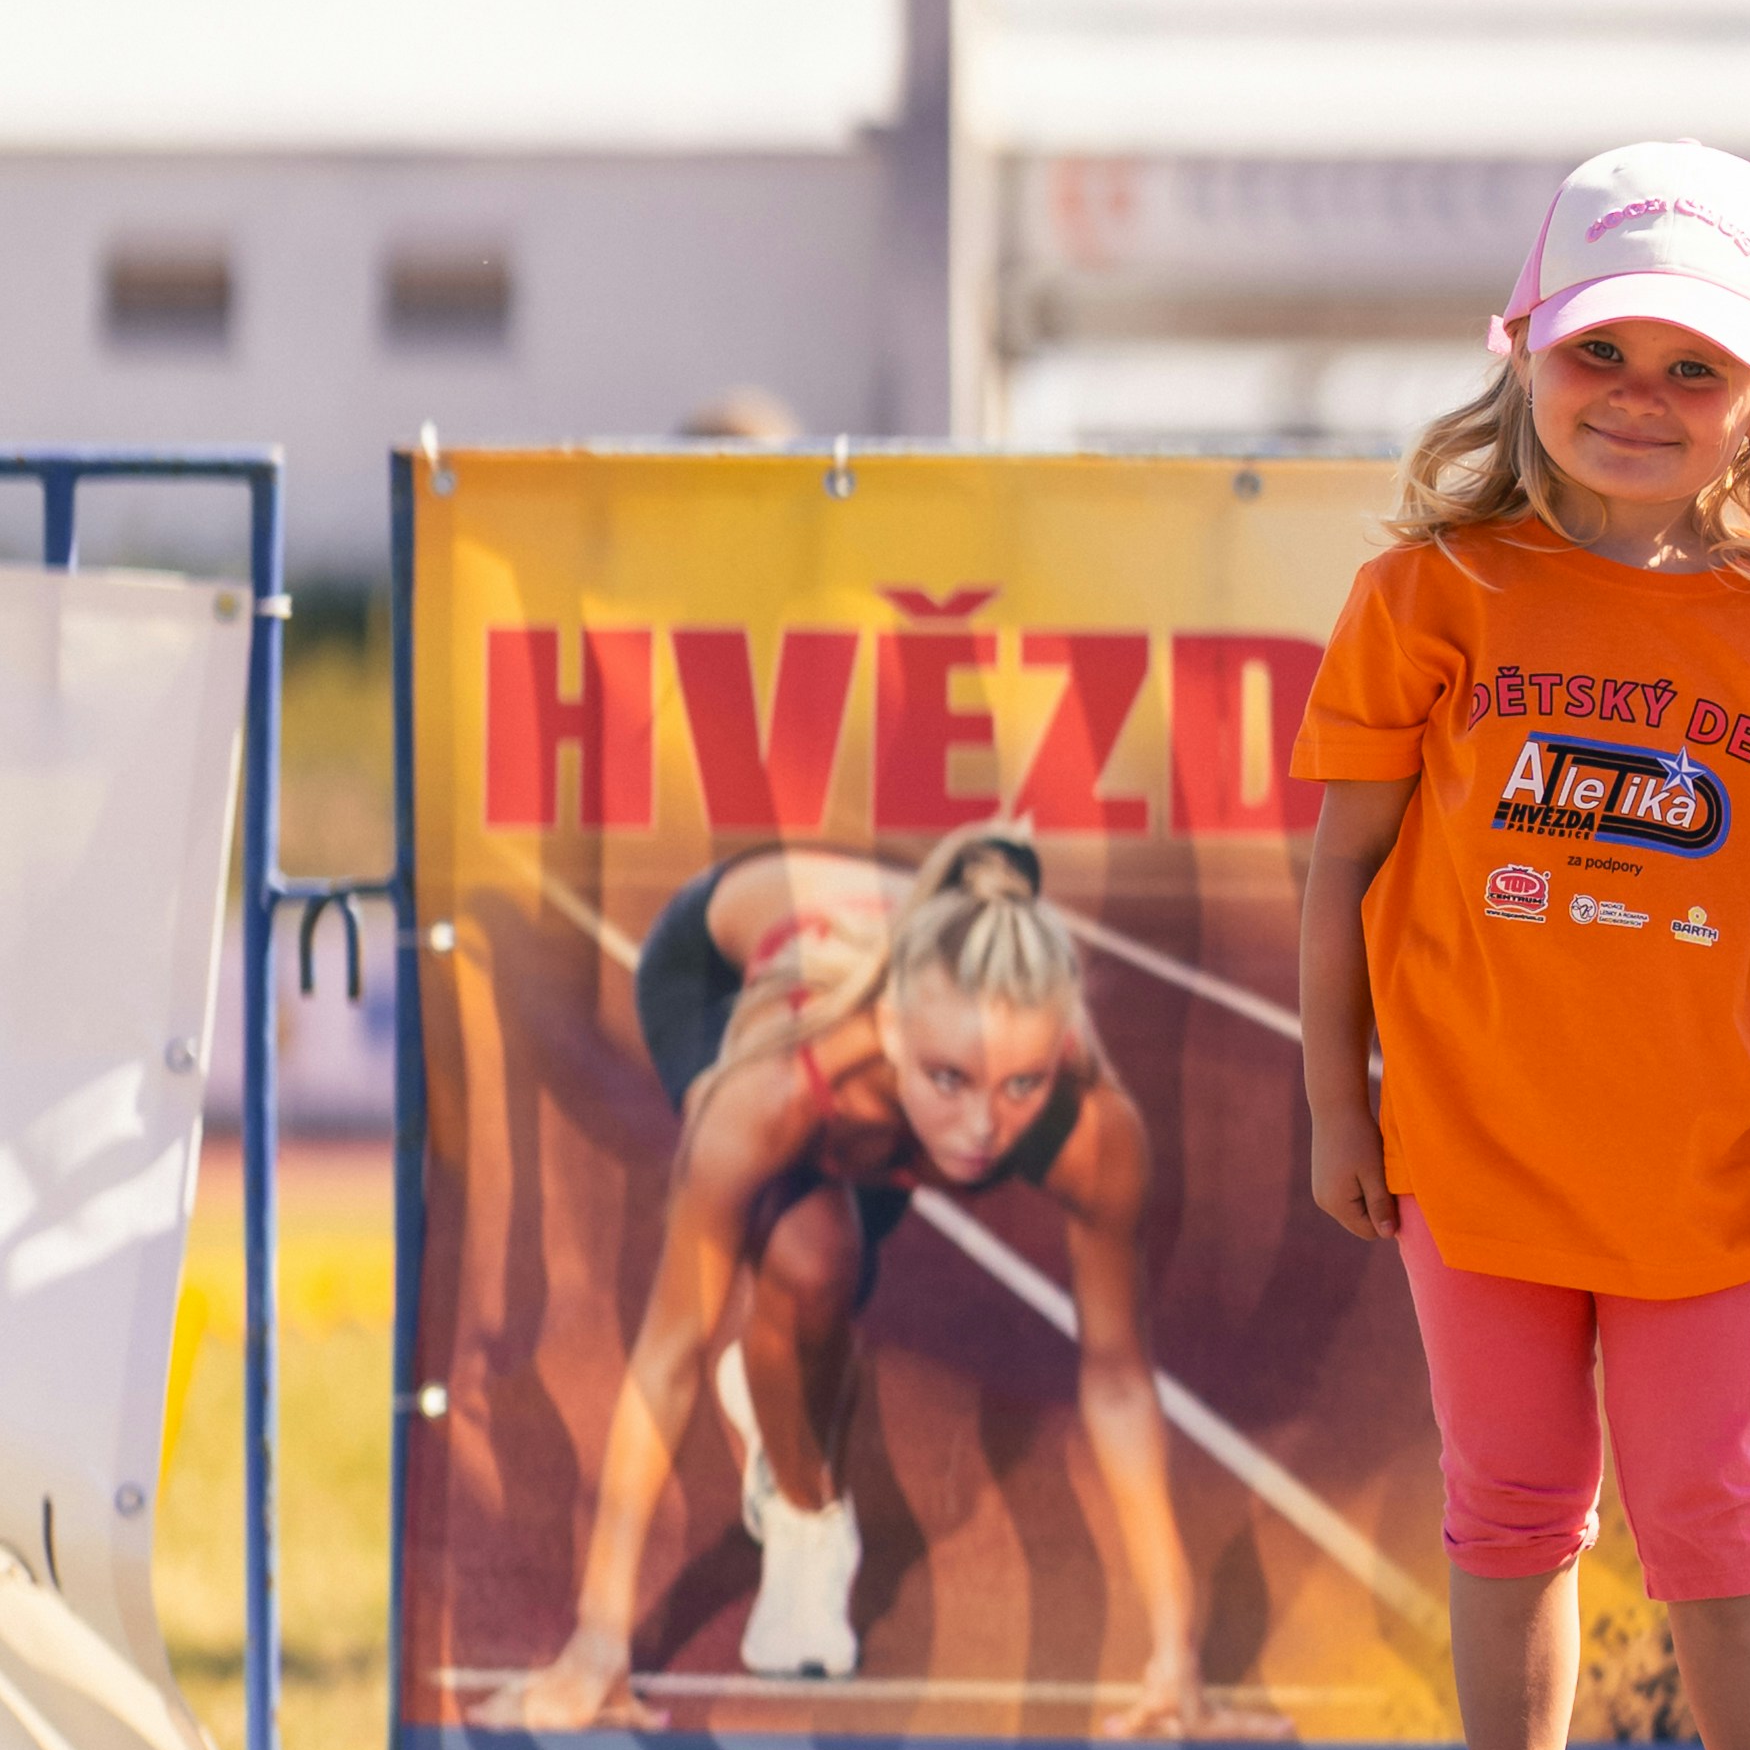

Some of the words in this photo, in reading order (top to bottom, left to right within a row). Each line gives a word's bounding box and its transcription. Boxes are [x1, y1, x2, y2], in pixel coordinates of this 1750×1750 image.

[484, 583, 1325, 834] HVĚZD
[1468, 666, 1678, 732] DĚTSKÝ
[1507, 823, 1591, 840] PARDUBICE
[1567, 856, 1581, 867] za
[1585, 856, 1643, 877] podpory
[1488, 893, 1542, 904] CENTRUM
[1671, 921, 1717, 940] BARTH
